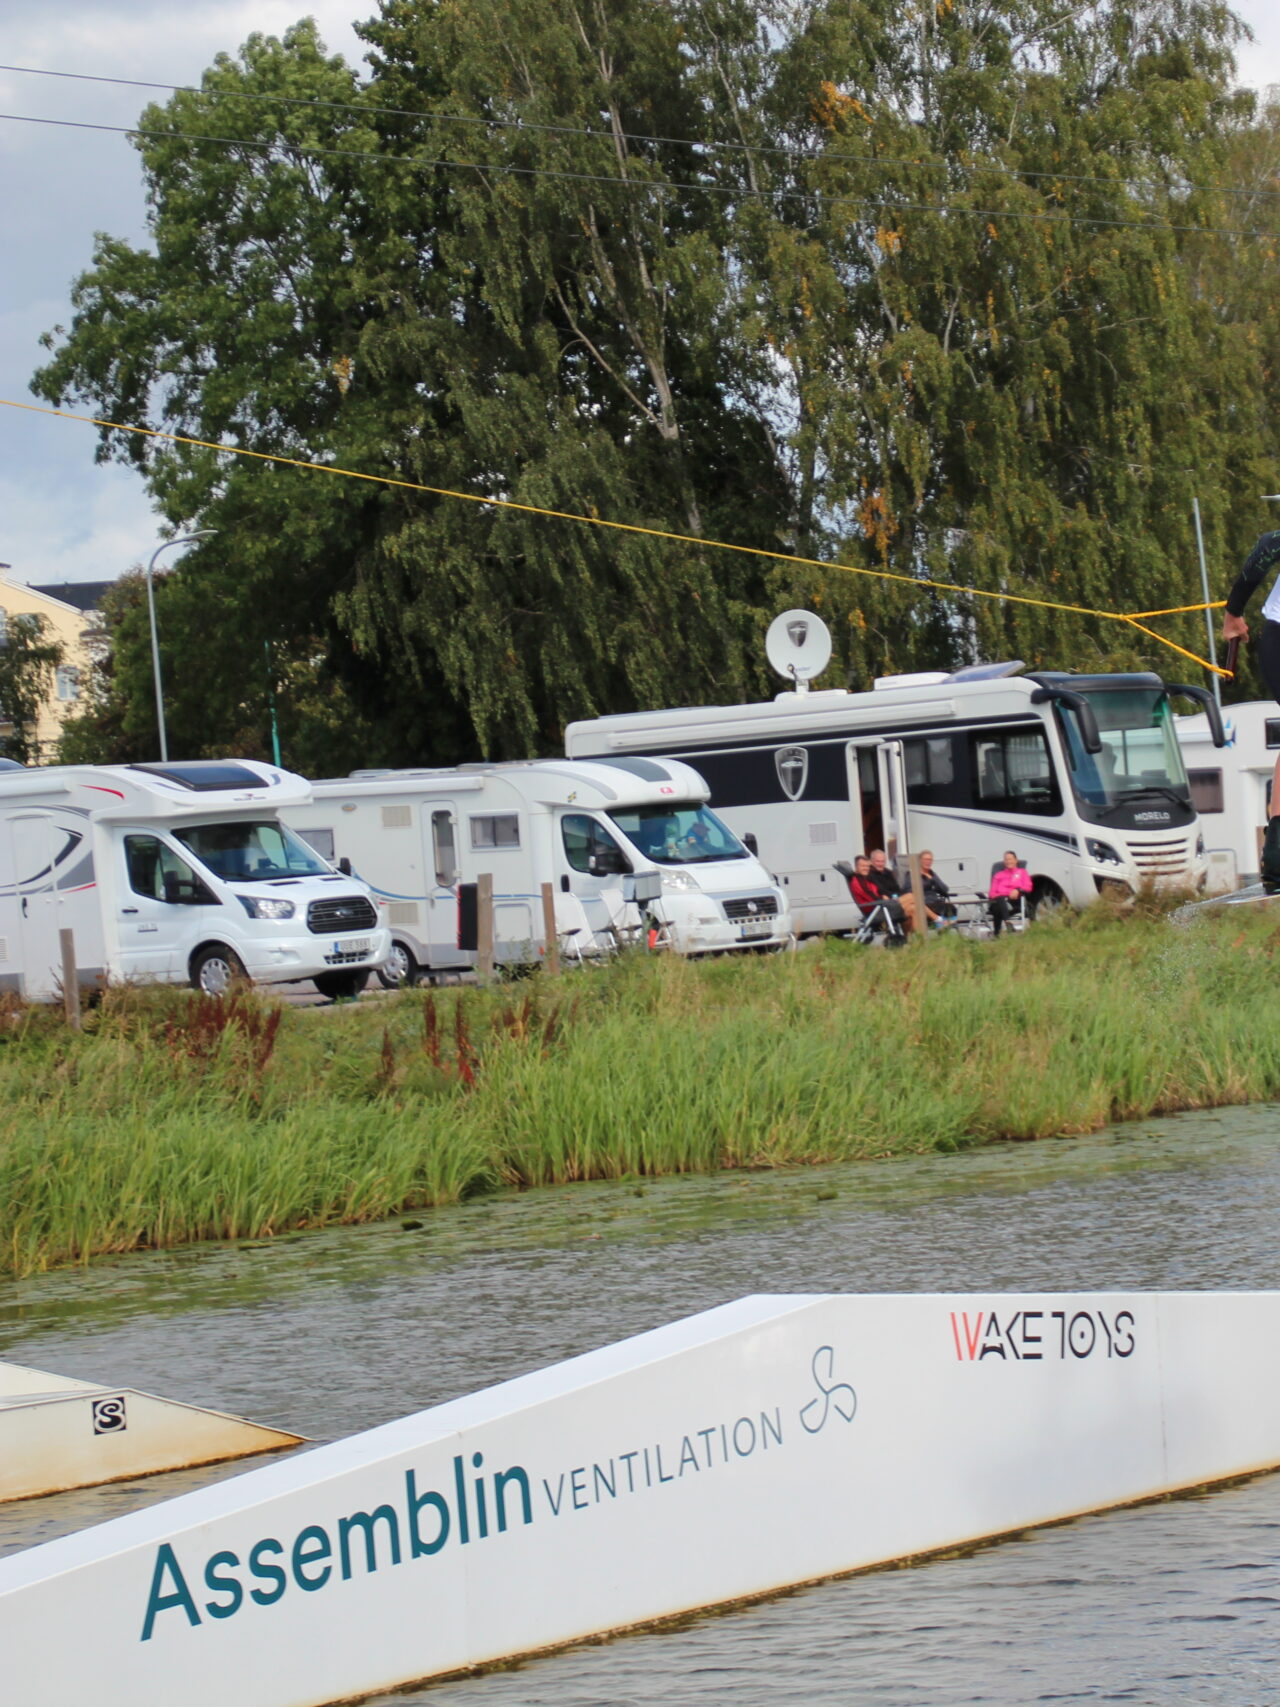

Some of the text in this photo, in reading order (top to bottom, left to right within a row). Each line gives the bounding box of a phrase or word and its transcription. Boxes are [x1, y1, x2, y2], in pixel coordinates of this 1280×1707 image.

[1133, 811, 1171, 821] MORELO
[950, 1310, 1136, 1361] WAKE TOYS
[140, 1407, 783, 1642] Assemblin VENTILATION
